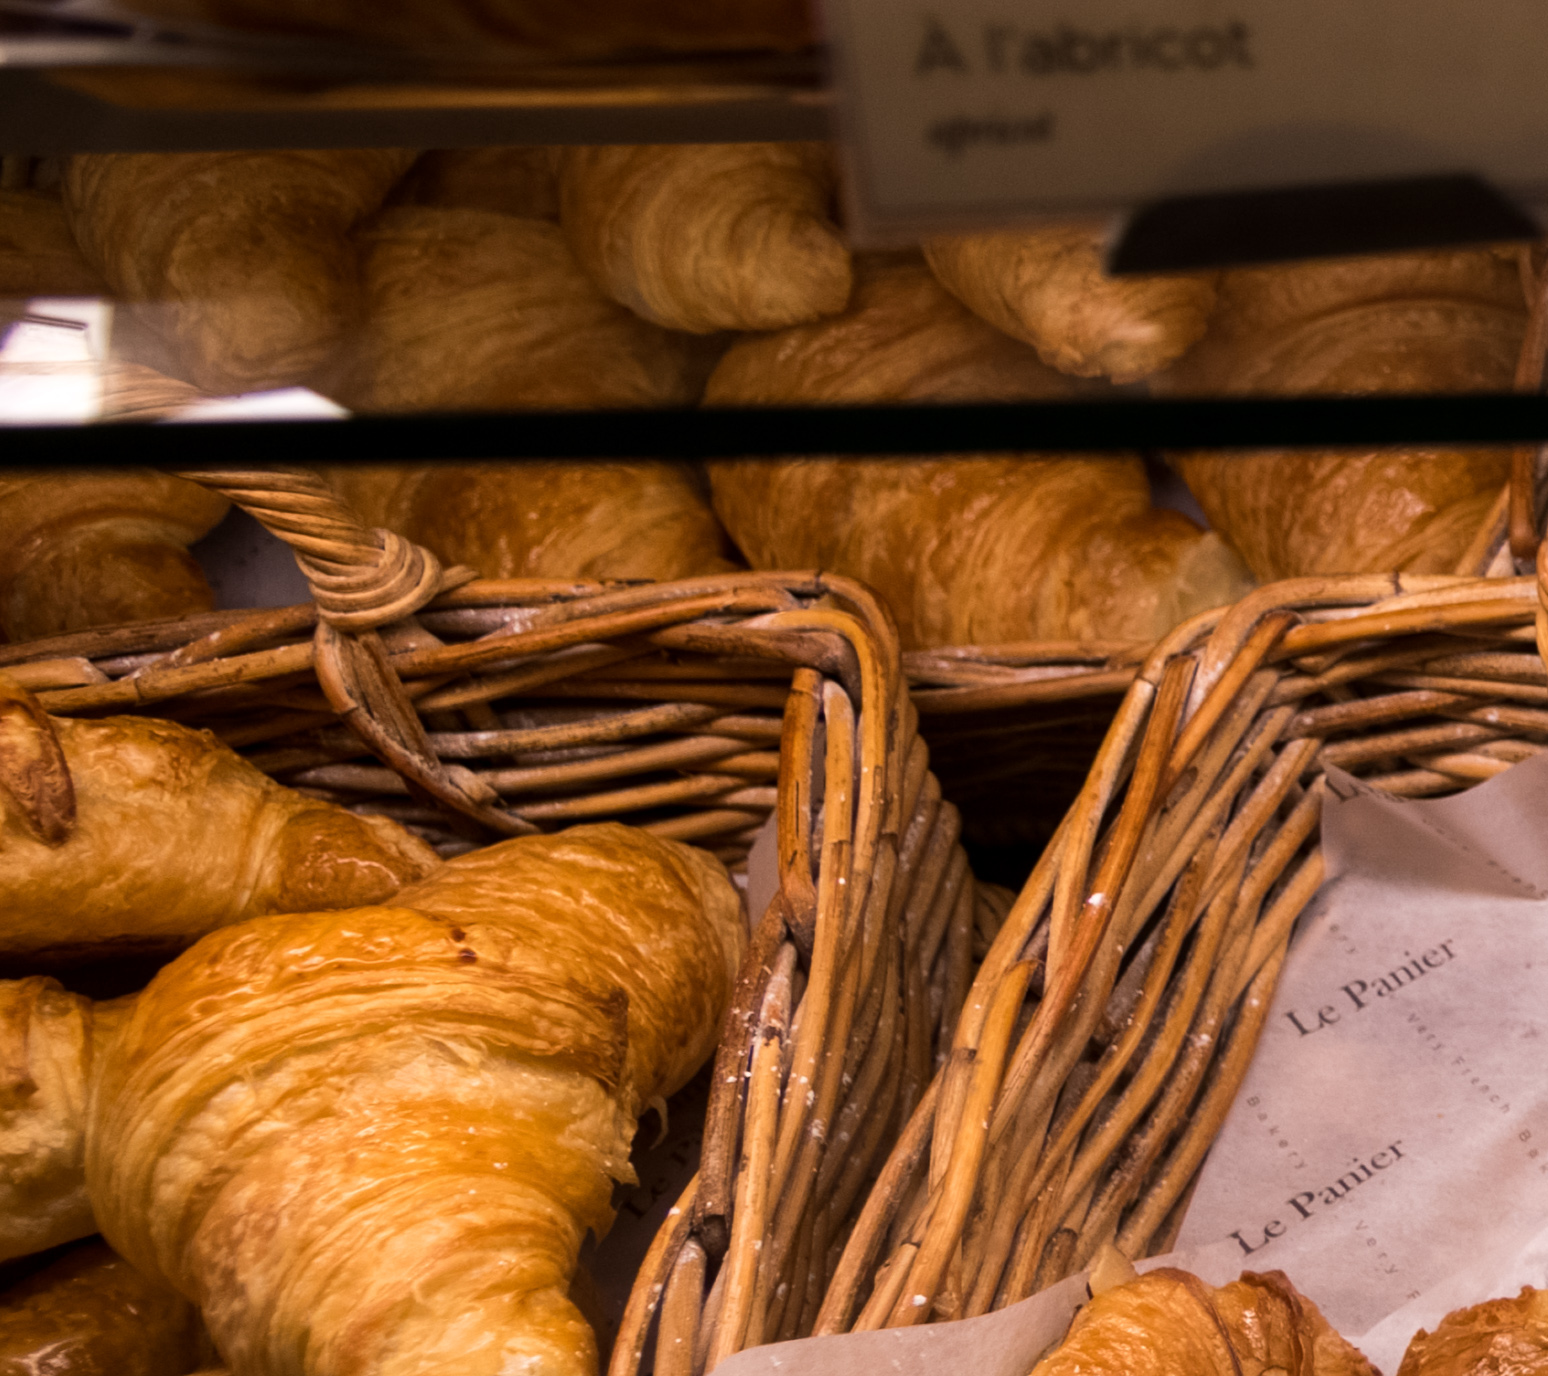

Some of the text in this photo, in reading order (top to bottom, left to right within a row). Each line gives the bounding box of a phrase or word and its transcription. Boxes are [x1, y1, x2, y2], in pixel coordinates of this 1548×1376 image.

[914, 10, 966, 75] À
[981, 20, 1254, 74] l'abricot
[1284, 1003, 1342, 1037] Le
[1338, 933, 1462, 1011] Panier
[1245, 1094, 1310, 1172] Bakery
[1227, 1138, 1410, 1258] Le Panier
[1353, 1218, 1402, 1277] Very
